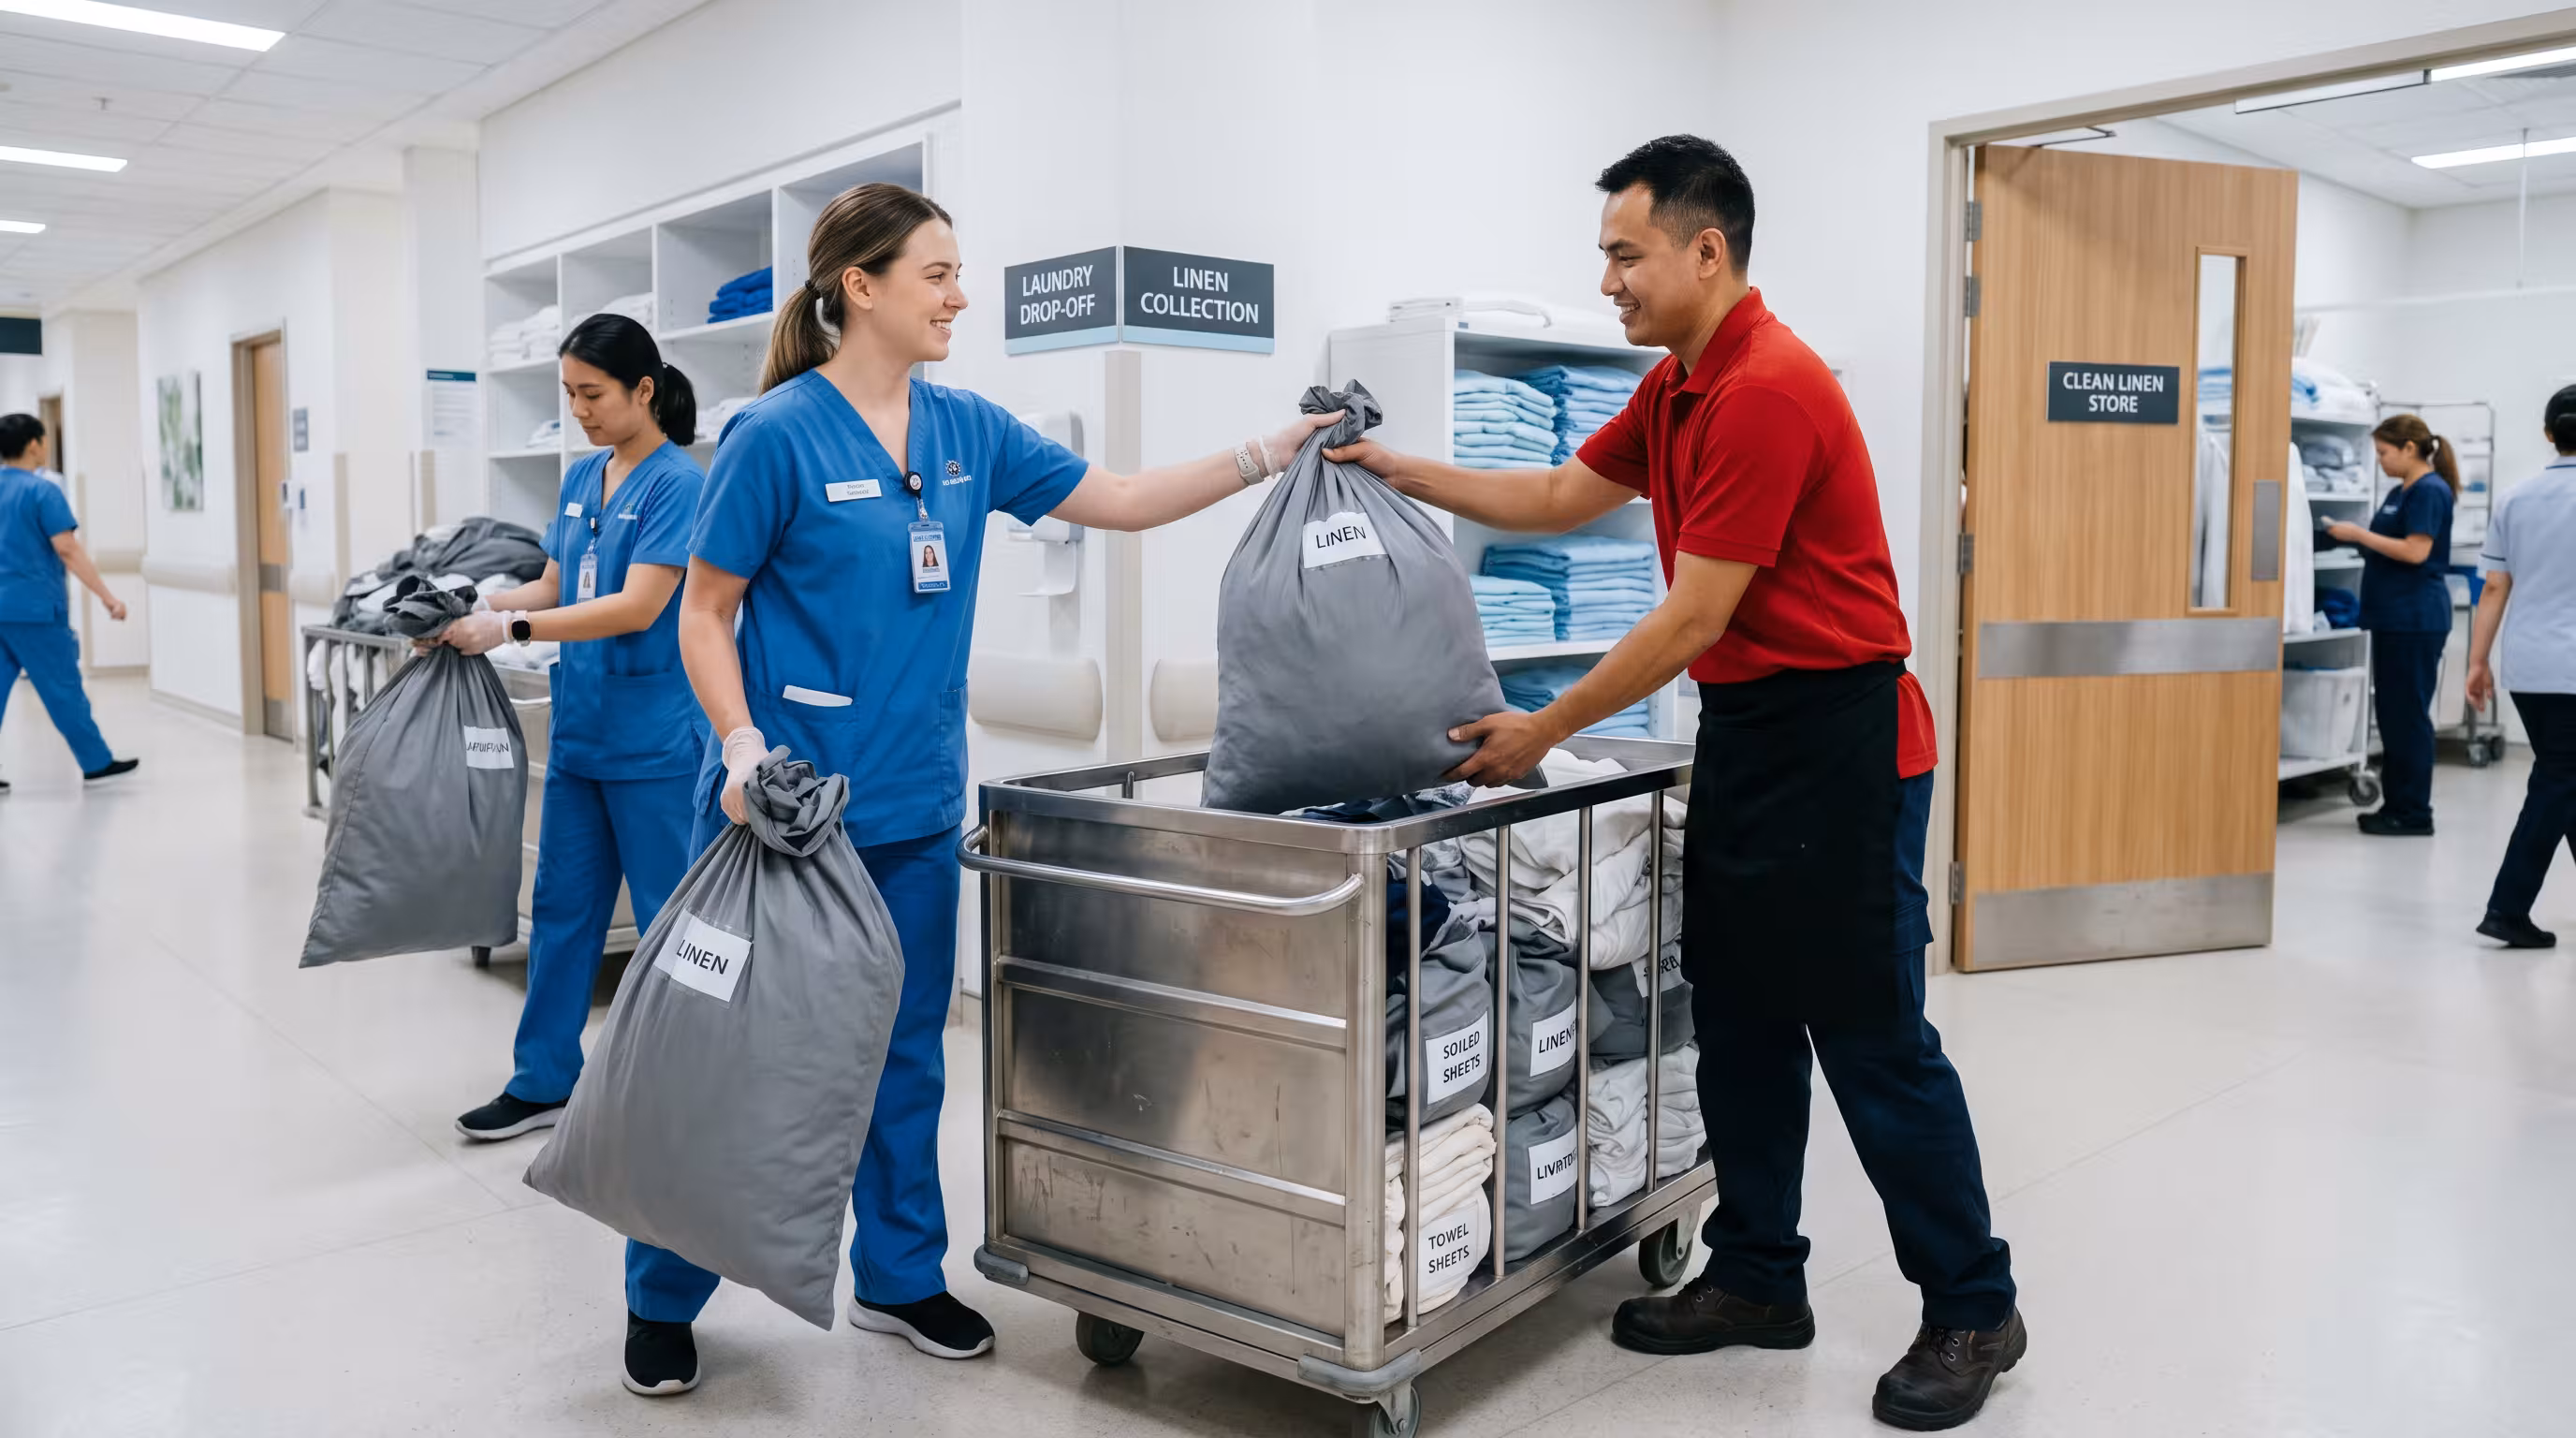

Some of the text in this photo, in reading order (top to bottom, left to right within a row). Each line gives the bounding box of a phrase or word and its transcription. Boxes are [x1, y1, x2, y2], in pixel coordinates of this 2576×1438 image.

[1022, 264, 1093, 297] LAUNDRY
[1173, 266, 1228, 293] LINEN
[1020, 293, 1095, 325] DROP-OFF
[1140, 292, 1259, 324] COLLECTION
[2062, 372, 2164, 392] CLEAN LINEN
[2088, 394, 2138, 413] STORE
[1316, 526, 1367, 549] LINEN
[676, 939, 729, 976] LINEN
[1443, 1031, 1480, 1060] SOILED
[1443, 1053, 1481, 1084] SHEETS
[1428, 1223, 1470, 1250] TOWEL
[1428, 1244, 1470, 1274] SHEETS
